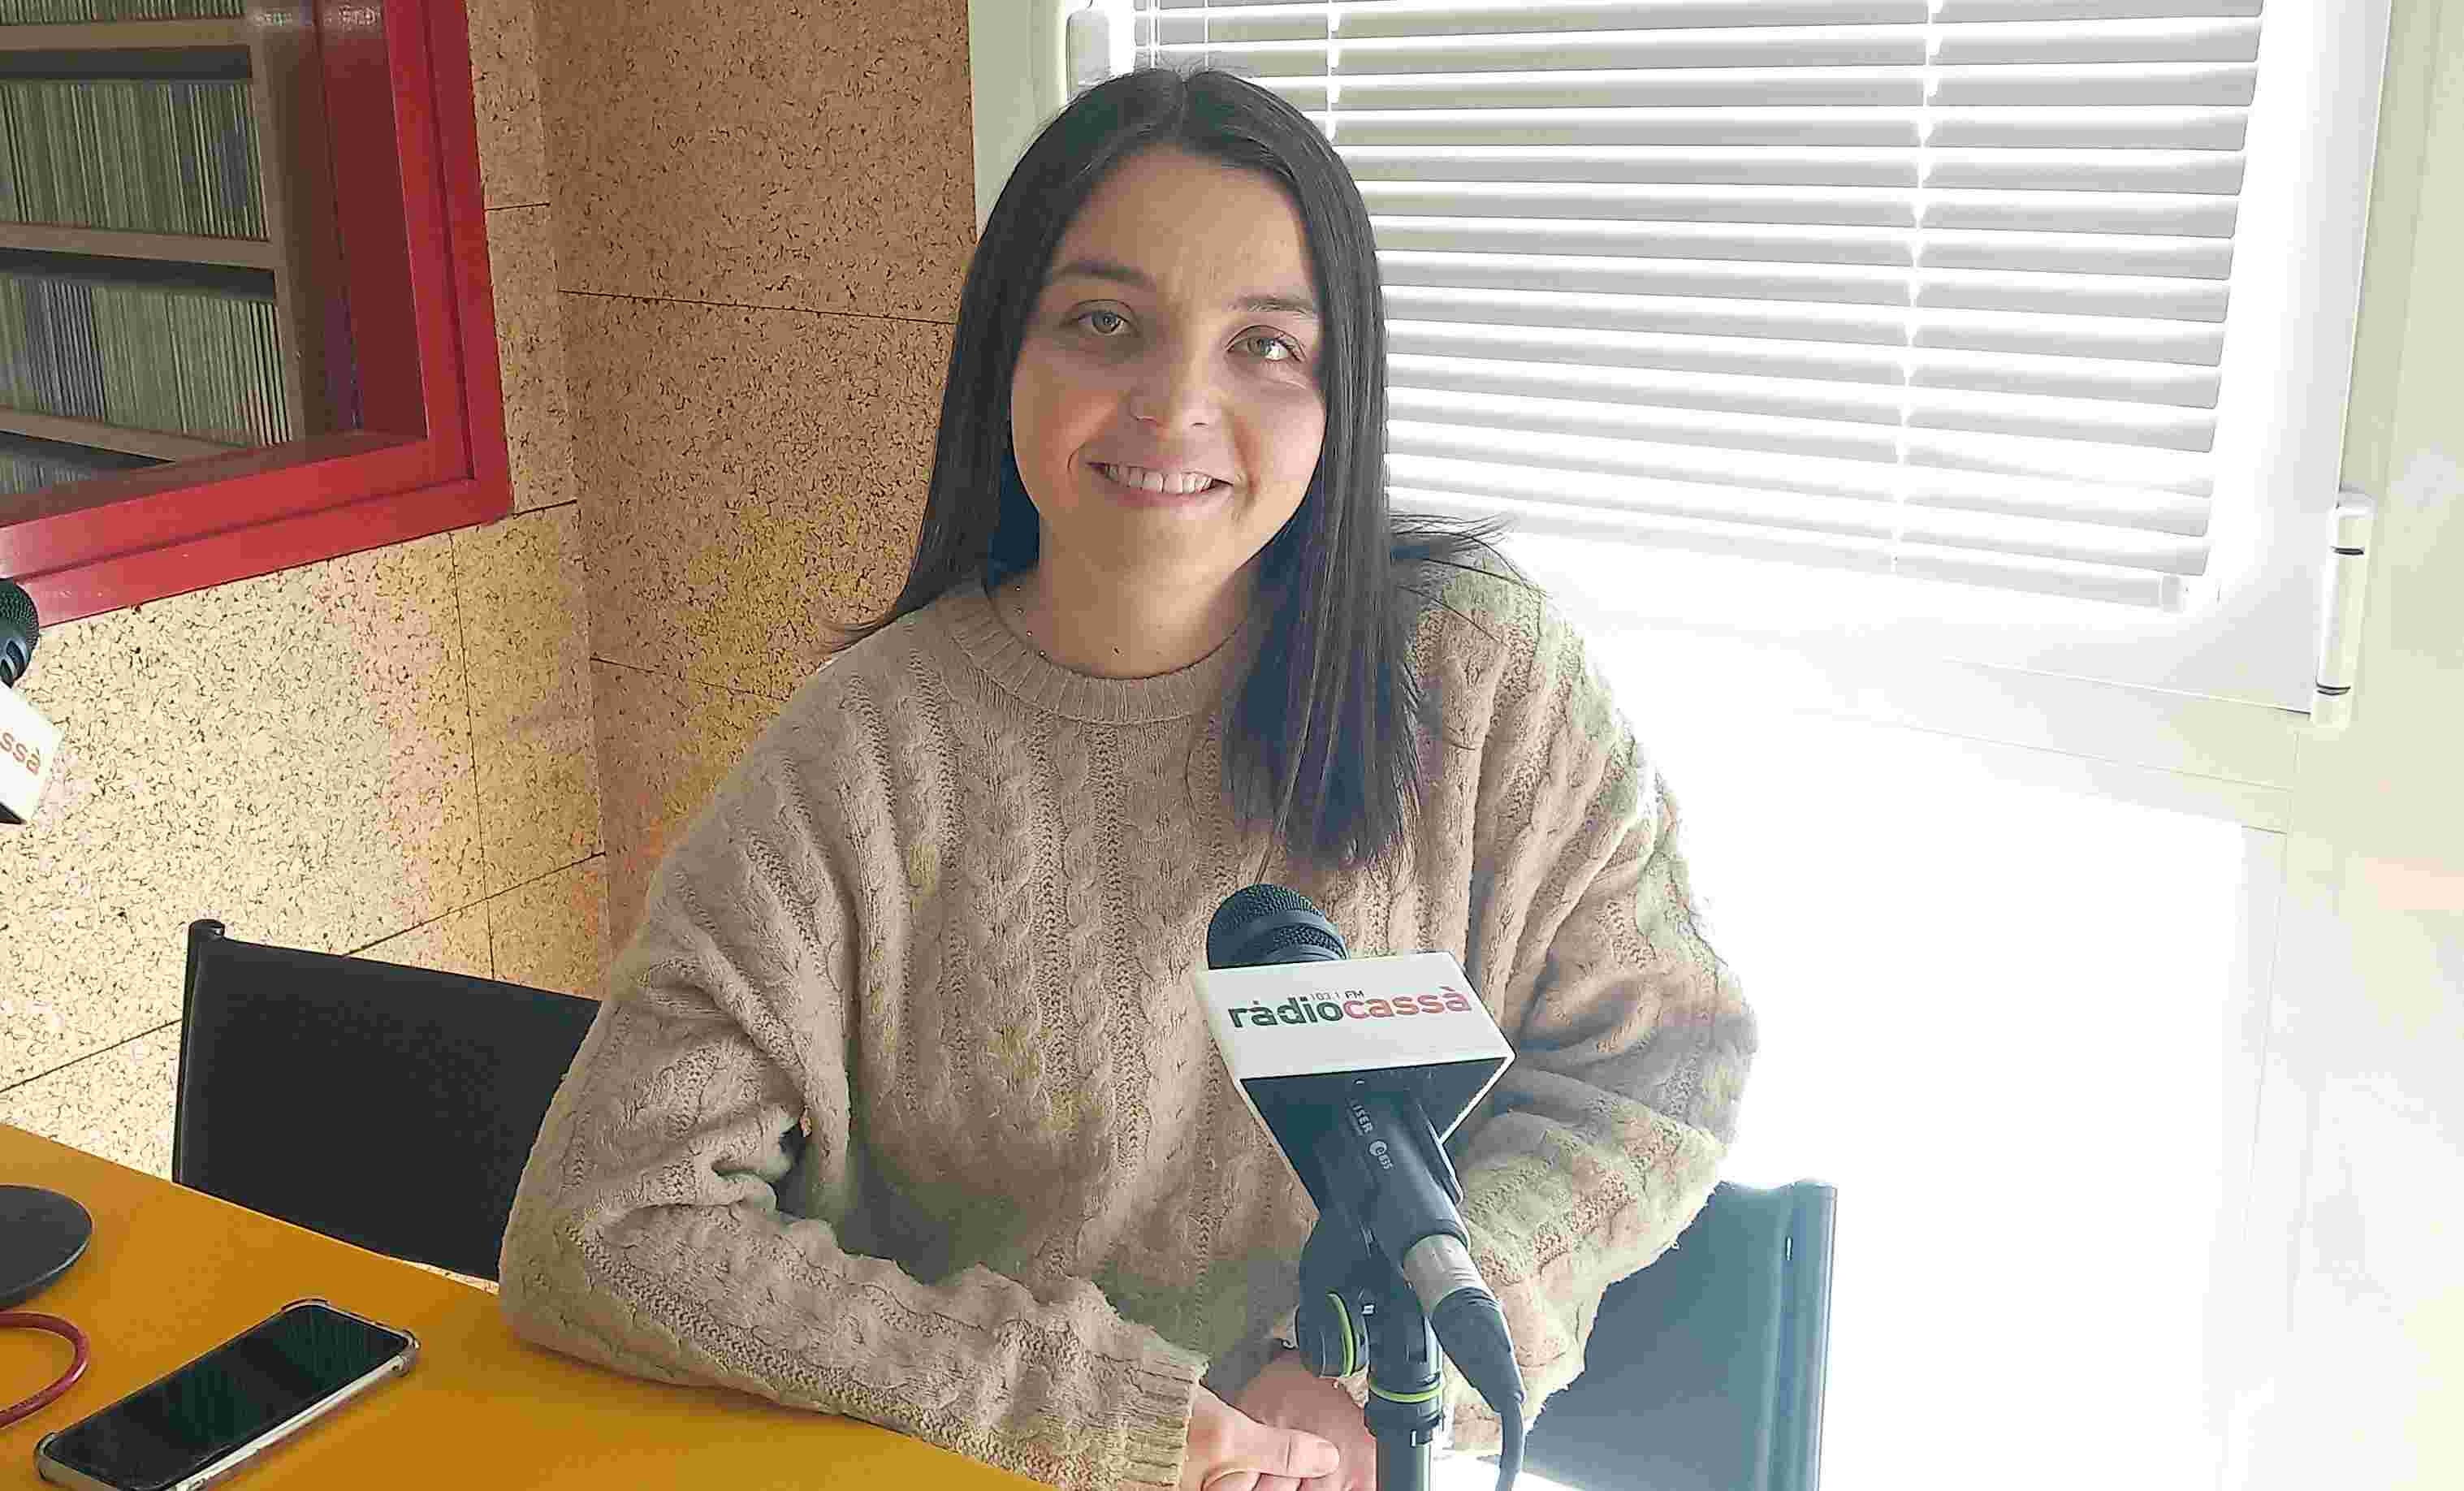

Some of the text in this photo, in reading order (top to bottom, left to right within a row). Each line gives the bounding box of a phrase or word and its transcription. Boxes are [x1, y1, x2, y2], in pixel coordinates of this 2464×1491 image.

[0, 732, 41, 775] ssà
[1345, 989, 1364, 1000] FM
[1351, 1103, 1373, 1133] ISER
